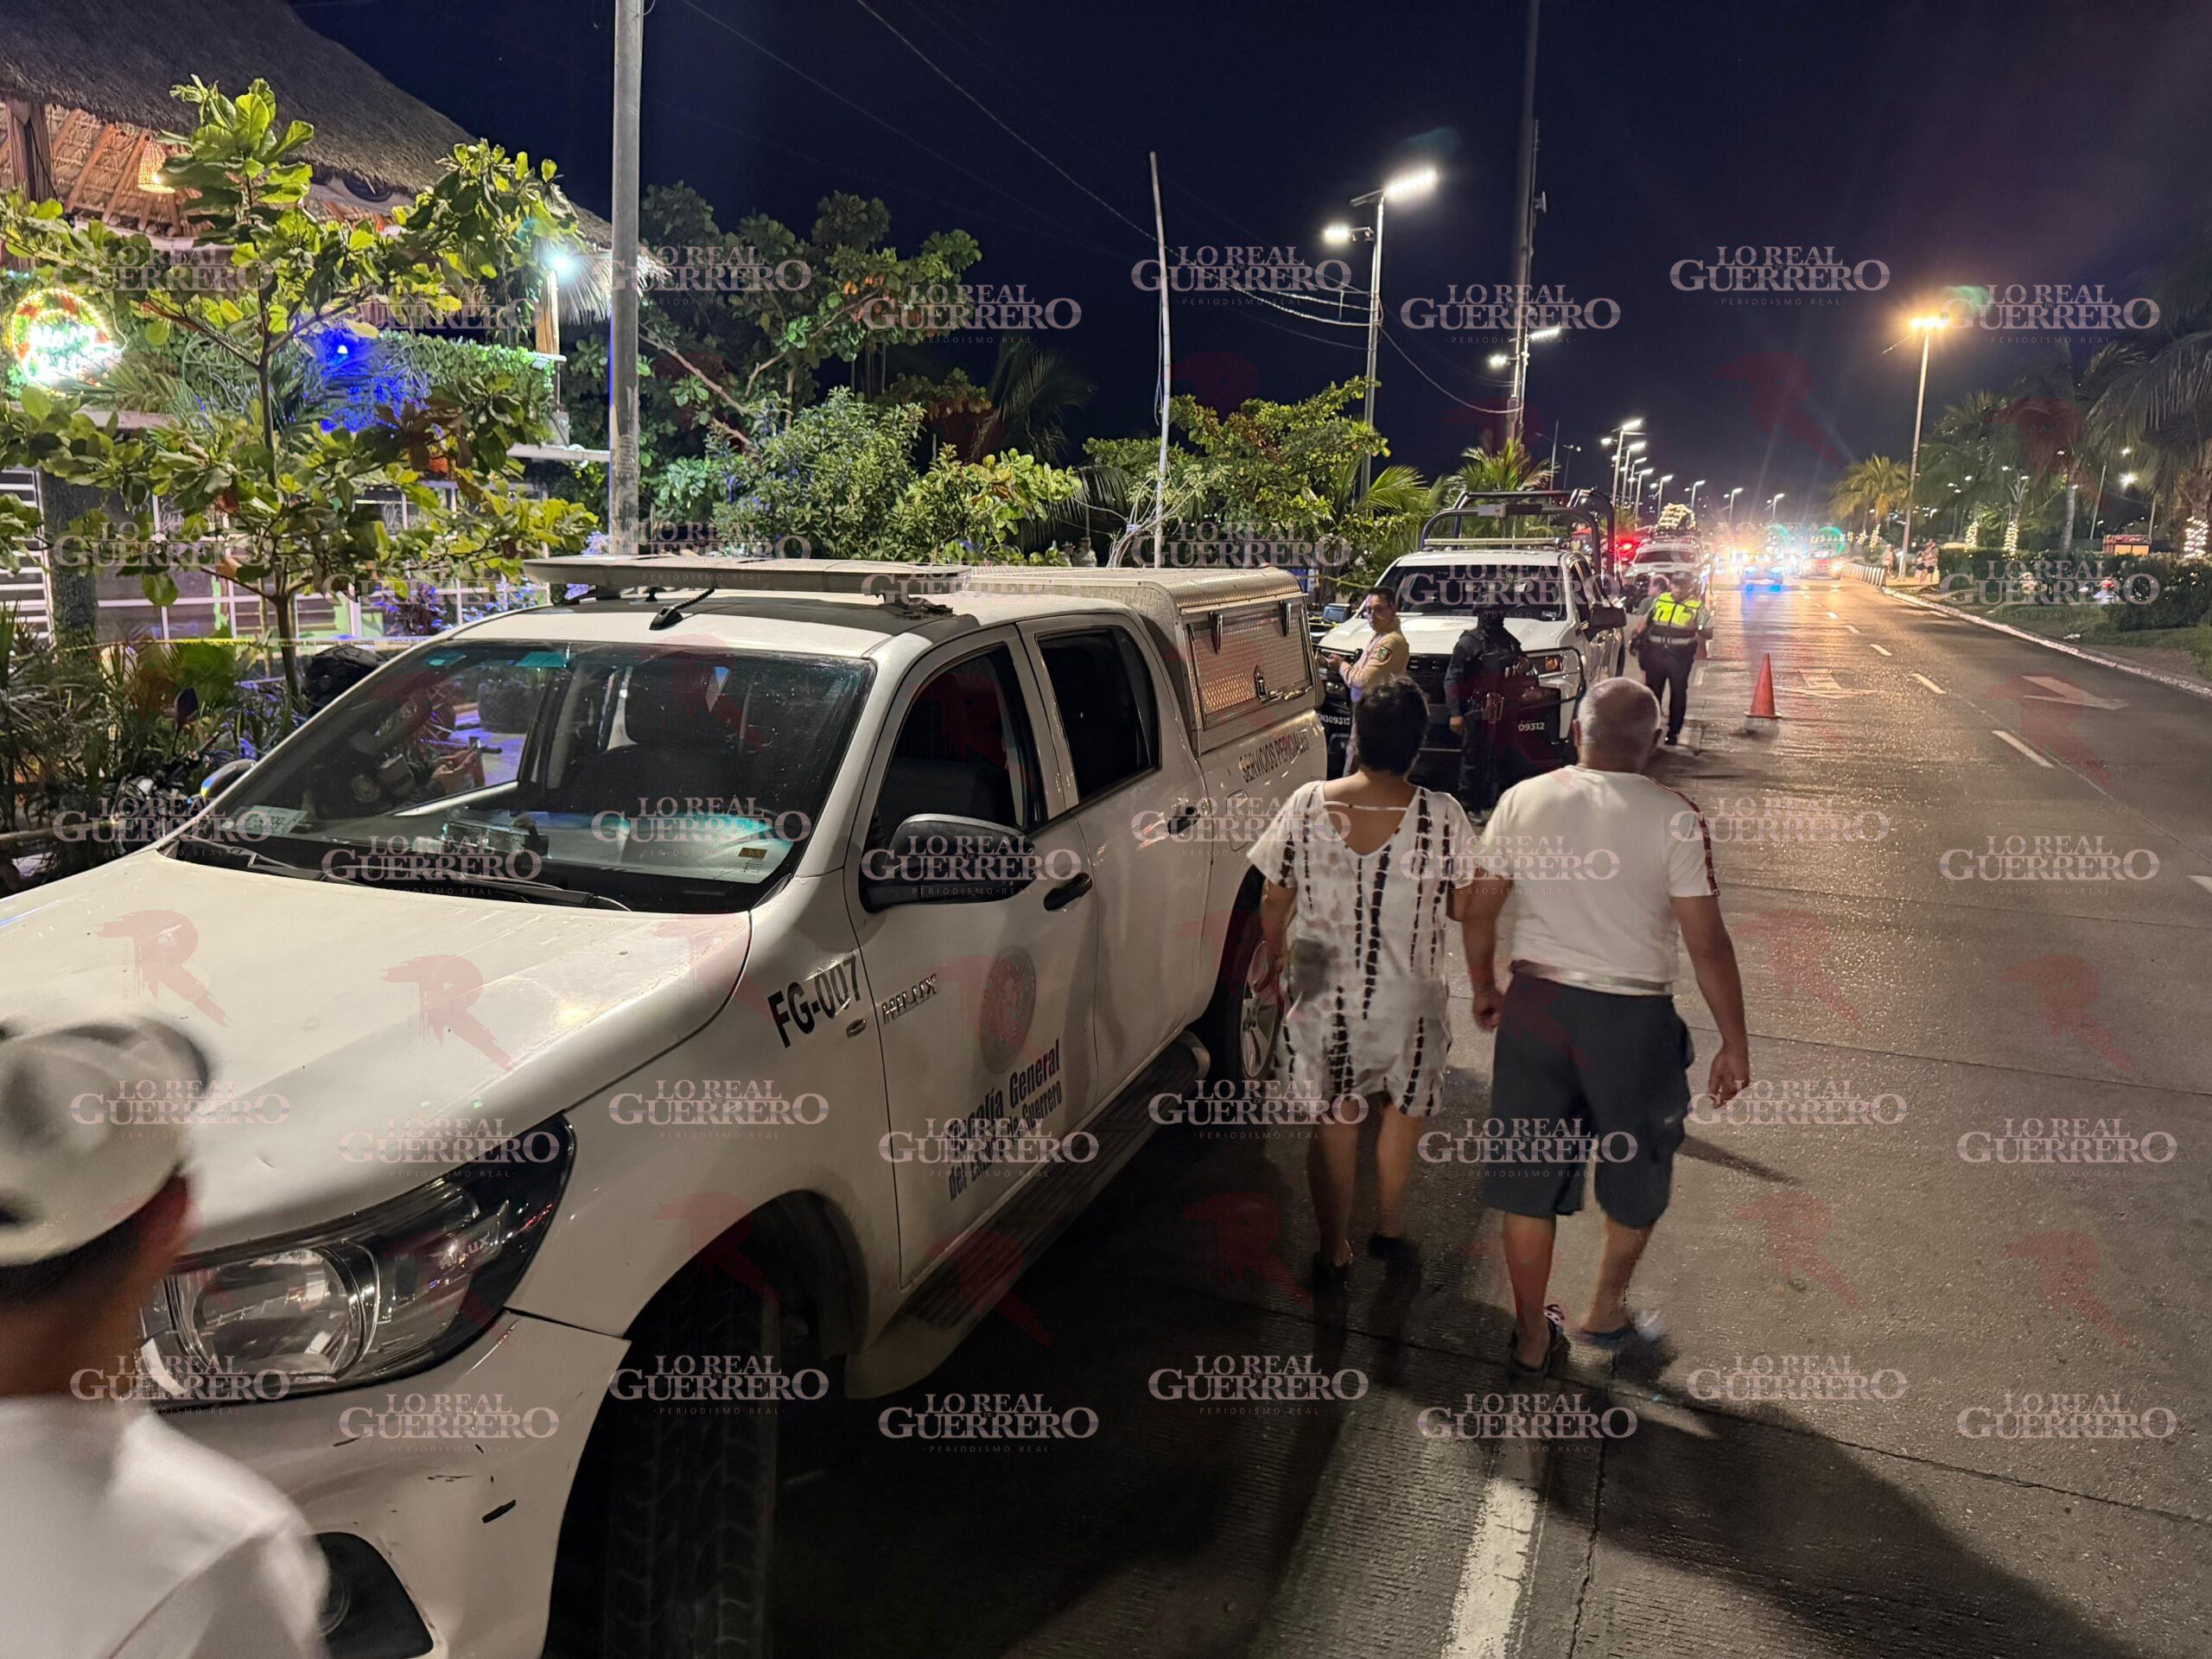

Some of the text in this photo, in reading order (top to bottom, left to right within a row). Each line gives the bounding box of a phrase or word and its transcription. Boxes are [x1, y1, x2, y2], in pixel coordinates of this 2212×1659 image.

[1518, 722, 1545, 732] 09312
[767, 954, 861, 1048] FG-007
[881, 973, 937, 1024] HILUX
[1009, 1038, 1060, 1109] General
[1022, 1080, 1062, 1131] Guerrero
